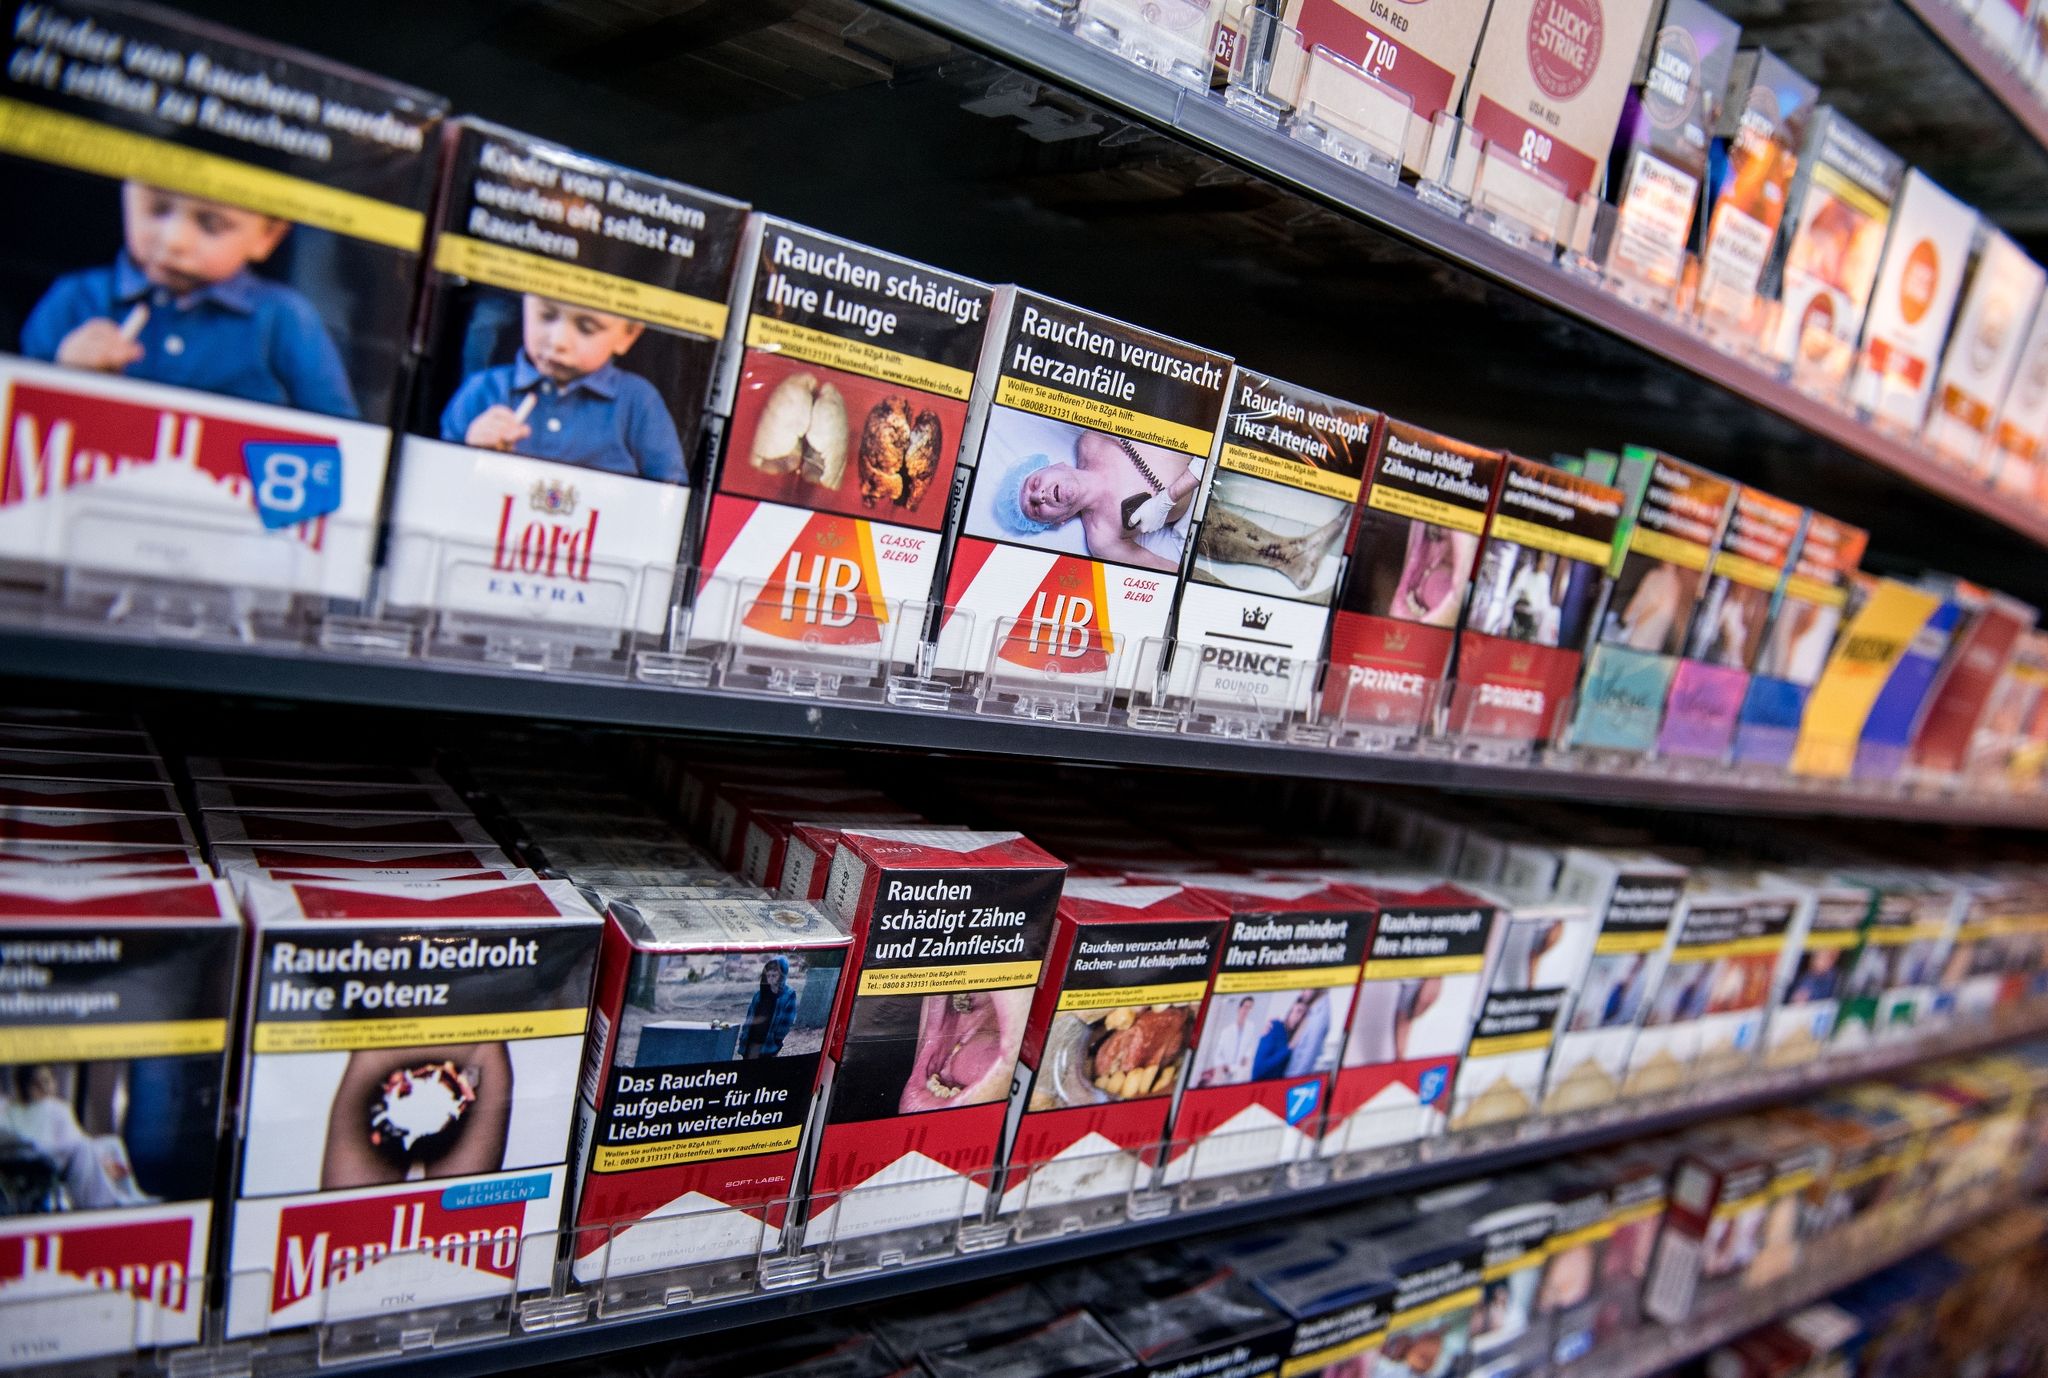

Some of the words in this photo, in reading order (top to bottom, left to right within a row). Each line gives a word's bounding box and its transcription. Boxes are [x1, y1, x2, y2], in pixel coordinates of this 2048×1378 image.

[1370, 0, 1389, 21] USA
[1390, 12, 1409, 32] RED
[1547, 0, 1593, 45] LUCKY
[1538, 22, 1587, 70] STRIKE
[480, 142, 558, 187] Kinder
[561, 170, 604, 198] von
[606, 179, 706, 230] Rauchern
[468, 206, 579, 258] Rauchern
[475, 179, 565, 223] werden
[566, 203, 601, 233] oft
[603, 214, 667, 251] selbst
[668, 231, 694, 258] zu
[774, 235, 881, 293] Rauchen
[885, 274, 982, 325] schädigt
[766, 273, 818, 313] Ihre
[823, 290, 898, 337] Lunge
[1021, 306, 1116, 357] Rauchen
[1121, 342, 1223, 390] verursacht
[882, 368, 963, 396] www.rauchfrei-info.de
[1012, 343, 1136, 401] Herzanfälle
[1007, 379, 1033, 394] Wollen
[1035, 387, 1046, 398] Sie
[1048, 390, 1085, 408] aufhören?
[1085, 401, 1098, 412] Die
[1099, 403, 1117, 418] BZgA
[1118, 409, 1135, 422] hilft:
[1241, 386, 1305, 423] Rauchen
[1308, 411, 1370, 444] verstopft
[1004, 394, 1019, 406] Tel.:
[1020, 397, 1070, 419] 08008313131
[1071, 412, 1114, 432] (kostenfrei),
[1115, 423, 1189, 450] www.rauchfrei-info.de
[1234, 414, 1266, 442] Ihre
[1268, 423, 1329, 459] Arterien
[1387, 435, 1432, 463] Rauchen
[1432, 452, 1475, 475] schädigt
[1381, 456, 1416, 482] Zähne
[1416, 467, 1437, 487] und
[1437, 472, 1490, 503] Zahnfleisch
[491, 494, 600, 583] Lord
[880, 534, 925, 550] CLASSIC
[882, 550, 918, 564] BLEND
[489, 578, 586, 604] EXTRA
[780, 550, 863, 628] HB
[1122, 576, 1160, 592] CLASSIC
[1124, 590, 1154, 604] BLEND
[1028, 590, 1095, 659] HB
[1201, 646, 1291, 679] PRINCE
[1215, 678, 1269, 695] ROUNDED
[1349, 665, 1425, 697] PRINCE
[1479, 683, 1545, 714] PRINCE
[887, 879, 972, 901] Rauchen
[880, 907, 967, 933] schädigt
[969, 906, 1026, 928] Zähne
[1232, 921, 1293, 942] Rauchen
[1294, 919, 1348, 939] mindert
[272, 939, 411, 974] Rauchen
[419, 936, 539, 970] bedroht
[876, 937, 916, 959] und
[919, 933, 1024, 957] Zahnfleisch
[1074, 957, 1117, 971] Rachen-
[1118, 954, 1138, 969] und
[1139, 952, 1207, 971] Kehlkopfkrebs
[1079, 939, 1123, 954] Rauchen
[1125, 937, 1177, 952] verursacht
[1225, 947, 1258, 967] Ihre
[1258, 942, 1347, 966] Fruchtbarkeit
[867, 982, 881, 990] Tel.:
[882, 981, 900, 989] 0800
[900, 980, 905, 988] 8
[905, 980, 928, 988] 313131
[929, 977, 967, 988] (kostenfrei),
[968, 972, 1033, 985] www.rauchfrei-info.de
[869, 973, 889, 981] Wollen
[899, 970, 928, 980] aufhören?
[939, 970, 953, 979] BZgA
[268, 979, 334, 1012] Ihre
[343, 979, 450, 1010] Potenz
[617, 1075, 655, 1093] Das
[659, 1069, 738, 1091] Rauchen
[612, 1096, 704, 1120] aufgeben
[724, 1090, 751, 1107] für
[753, 1086, 788, 1104] Ihre
[608, 1120, 671, 1141] Lieben
[677, 1109, 783, 1133] weiterleben
[603, 1158, 619, 1167] Tel.:
[620, 1157, 640, 1166] 0800
[640, 1156, 645, 1164] 8
[645, 1153, 671, 1163] 313131
[672, 1147, 715, 1161] (kostenfrei),
[716, 1139, 792, 1154] www.rauchfrei-info.de
[605, 1149, 630, 1158] Wollen
[630, 1148, 640, 1156] Sie
[641, 1144, 676, 1156] aufhören?
[675, 1142, 687, 1150] Die
[688, 1140, 705, 1151] BZgA
[706, 1138, 723, 1147] hilft:
[456, 1186, 536, 1206] WECHSELN?
[725, 1178, 753, 1188] SOFT
[755, 1175, 786, 1186] LABEL
[283, 1202, 518, 1301] Marlboro
[380, 1291, 416, 1307] mix
